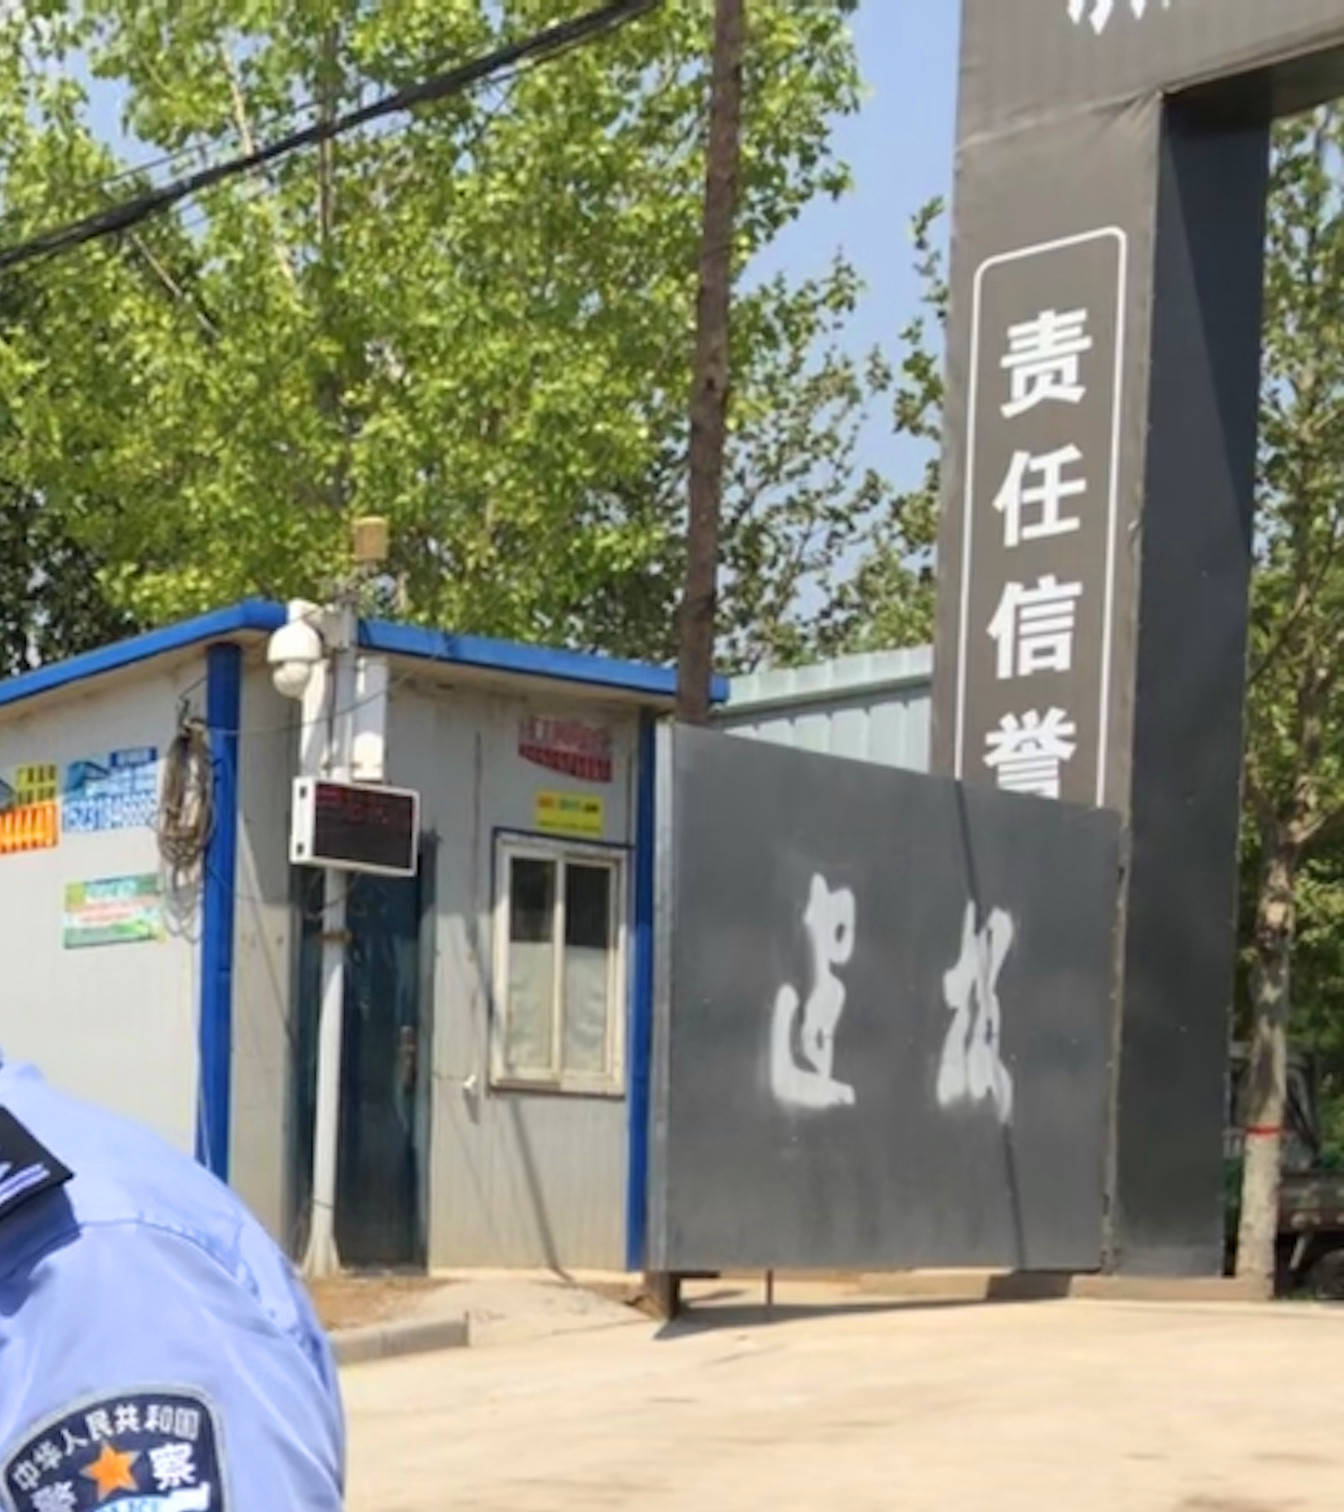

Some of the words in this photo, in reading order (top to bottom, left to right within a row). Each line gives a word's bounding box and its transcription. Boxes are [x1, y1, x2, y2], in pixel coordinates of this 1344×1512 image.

[983, 307, 1094, 799] 责任信誉
[10, 1403, 201, 1490] 中华人民共和国
